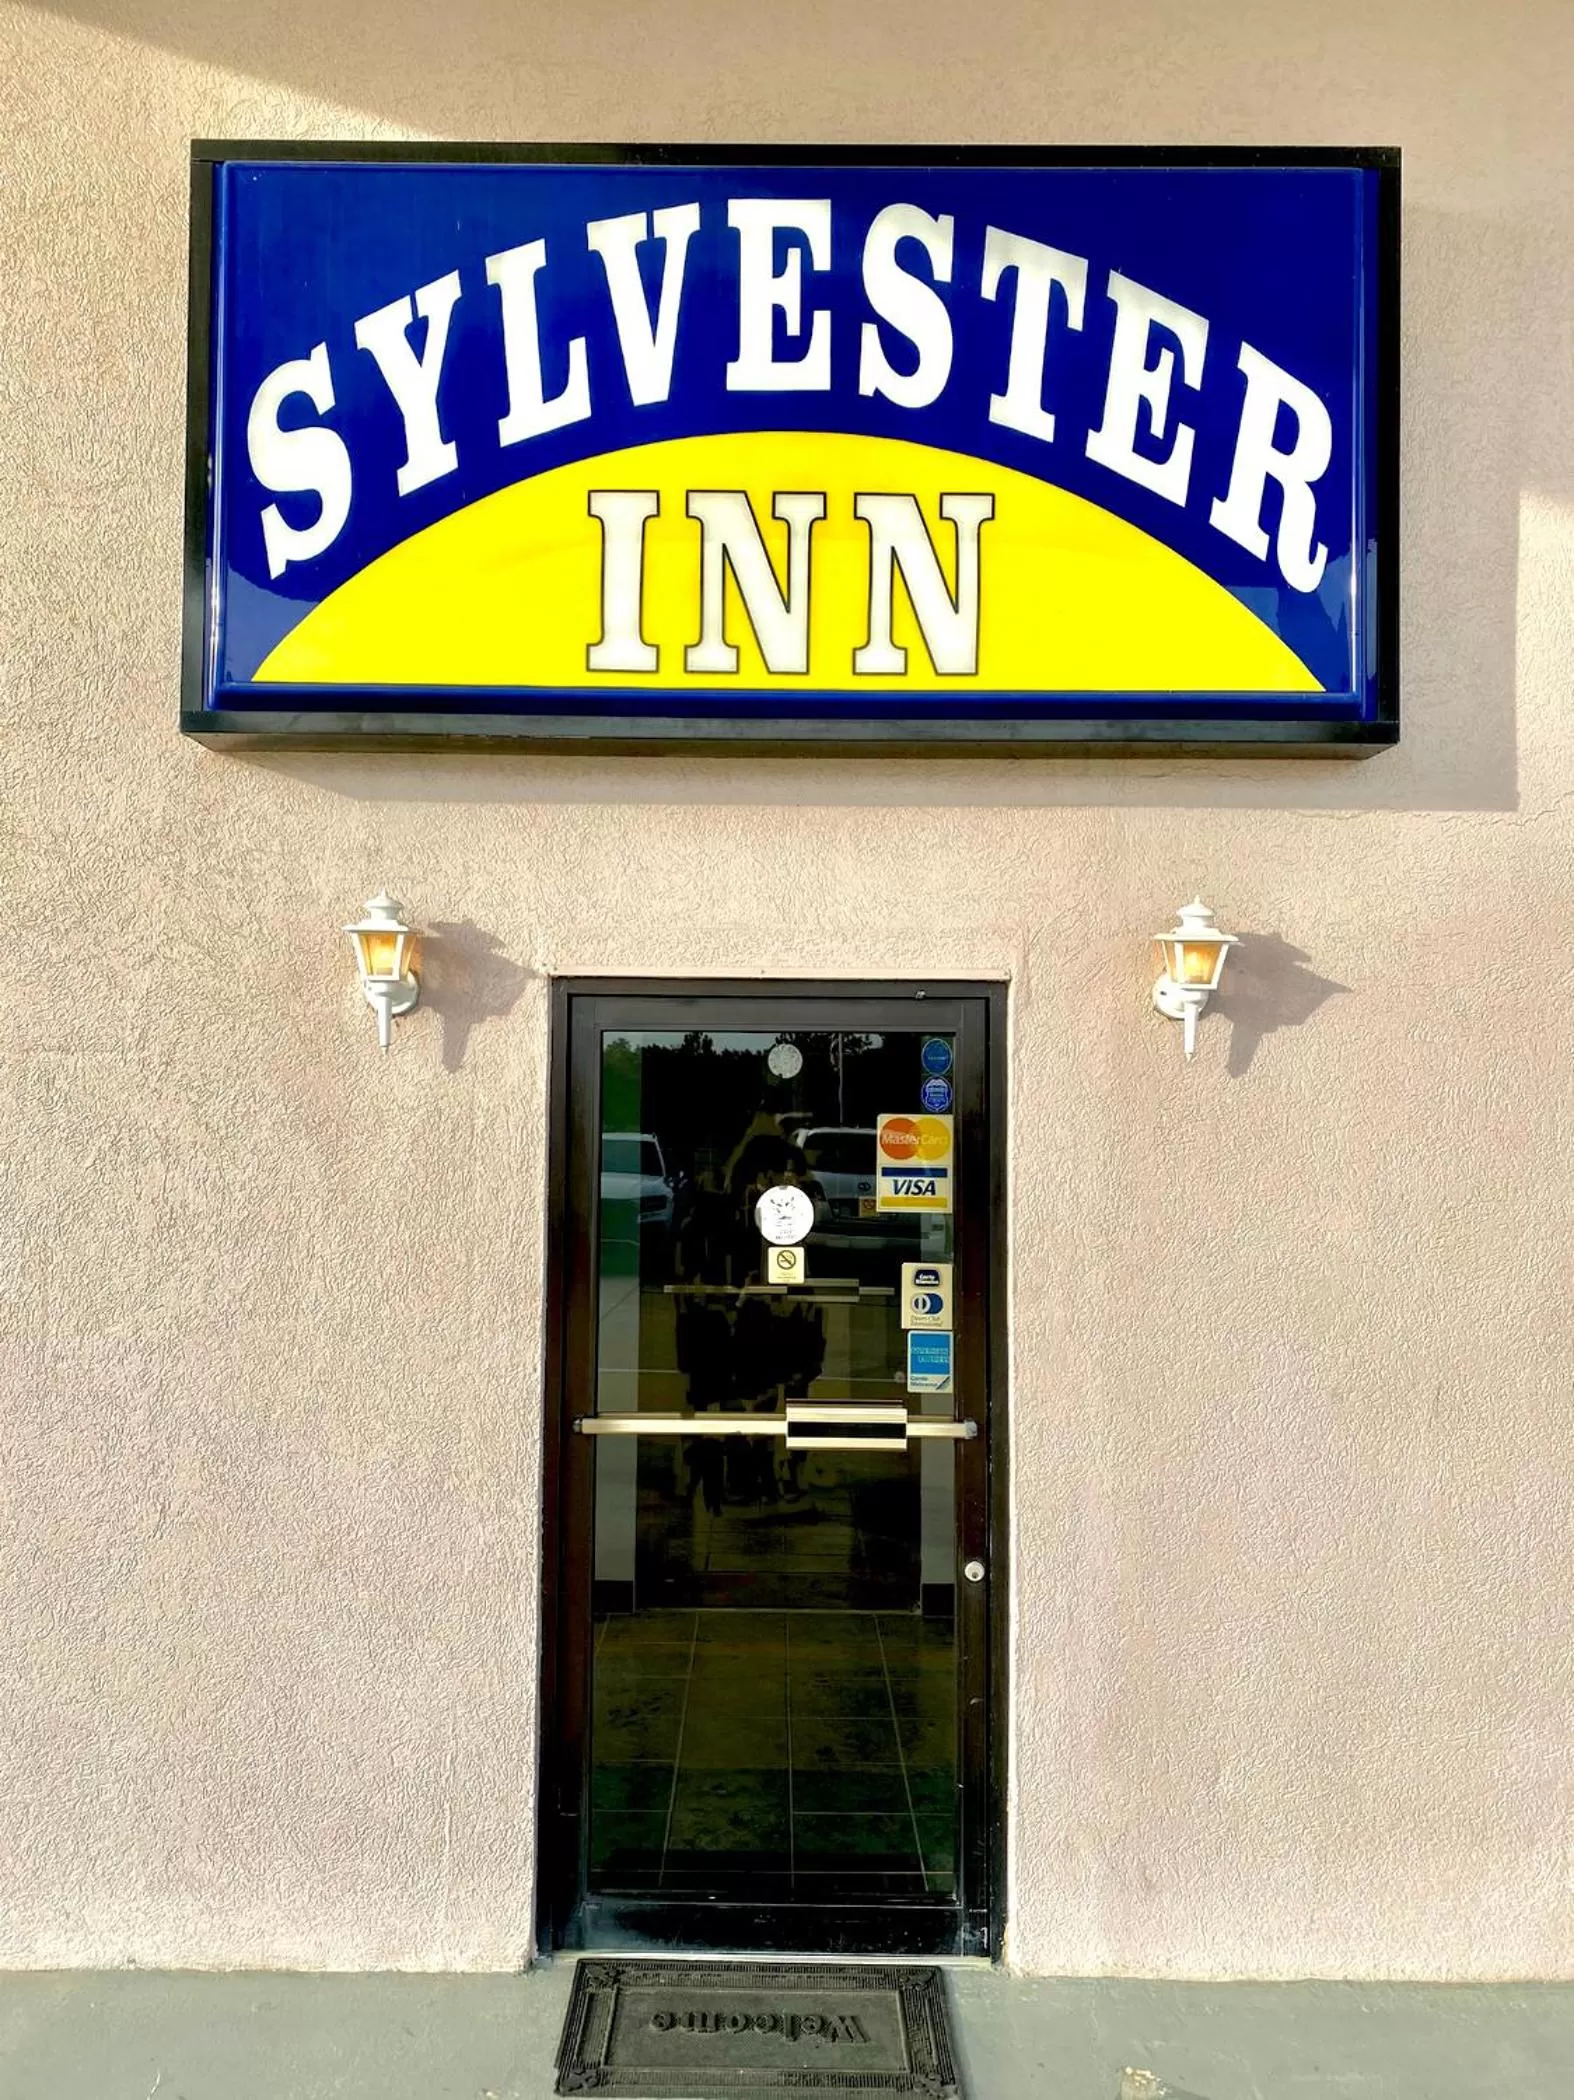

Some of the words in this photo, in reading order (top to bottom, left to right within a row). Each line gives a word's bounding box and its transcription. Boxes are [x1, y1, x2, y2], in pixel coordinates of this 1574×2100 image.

[246, 198, 1335, 594] SYLVESTER
[585, 489, 996, 676] INN
[892, 1178, 936, 1196] VISA
[651, 2010, 872, 2043] Welcome
